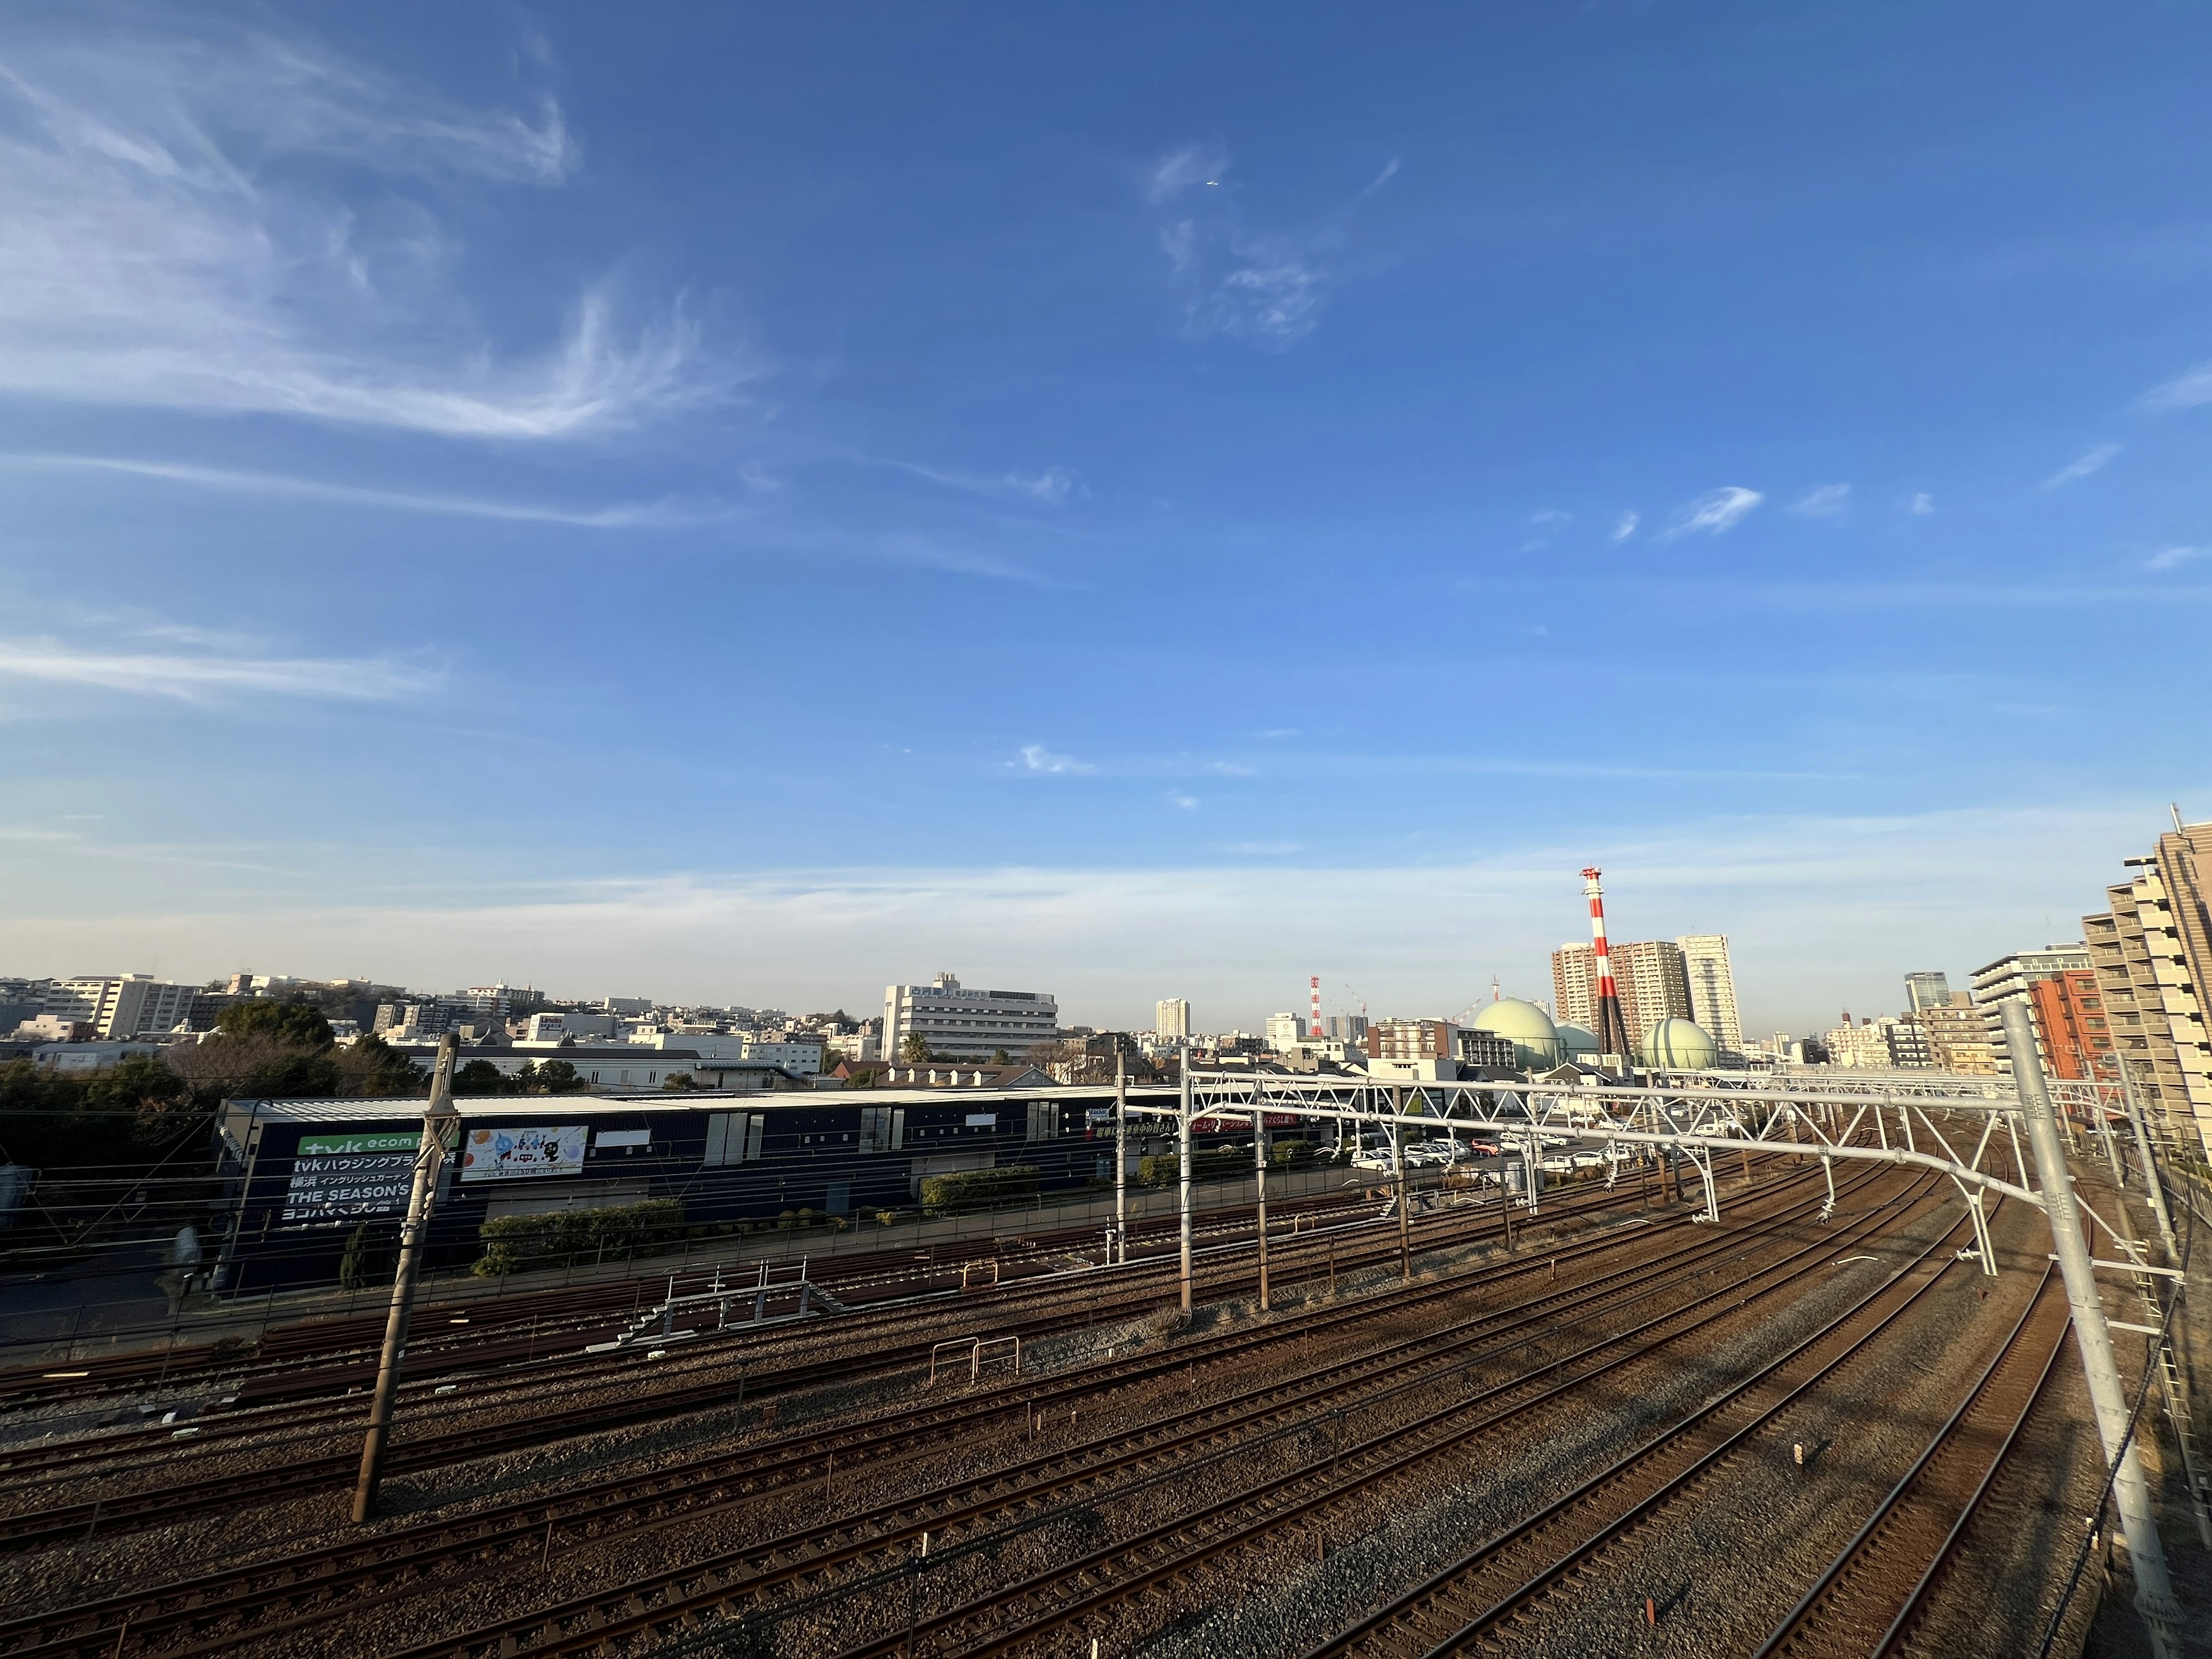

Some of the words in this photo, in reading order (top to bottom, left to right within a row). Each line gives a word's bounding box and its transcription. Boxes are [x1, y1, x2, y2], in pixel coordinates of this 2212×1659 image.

[367, 1135, 412, 1149] ecom
[287, 1190, 324, 1205] THE
[328, 1183, 410, 1202] SEASON'S
